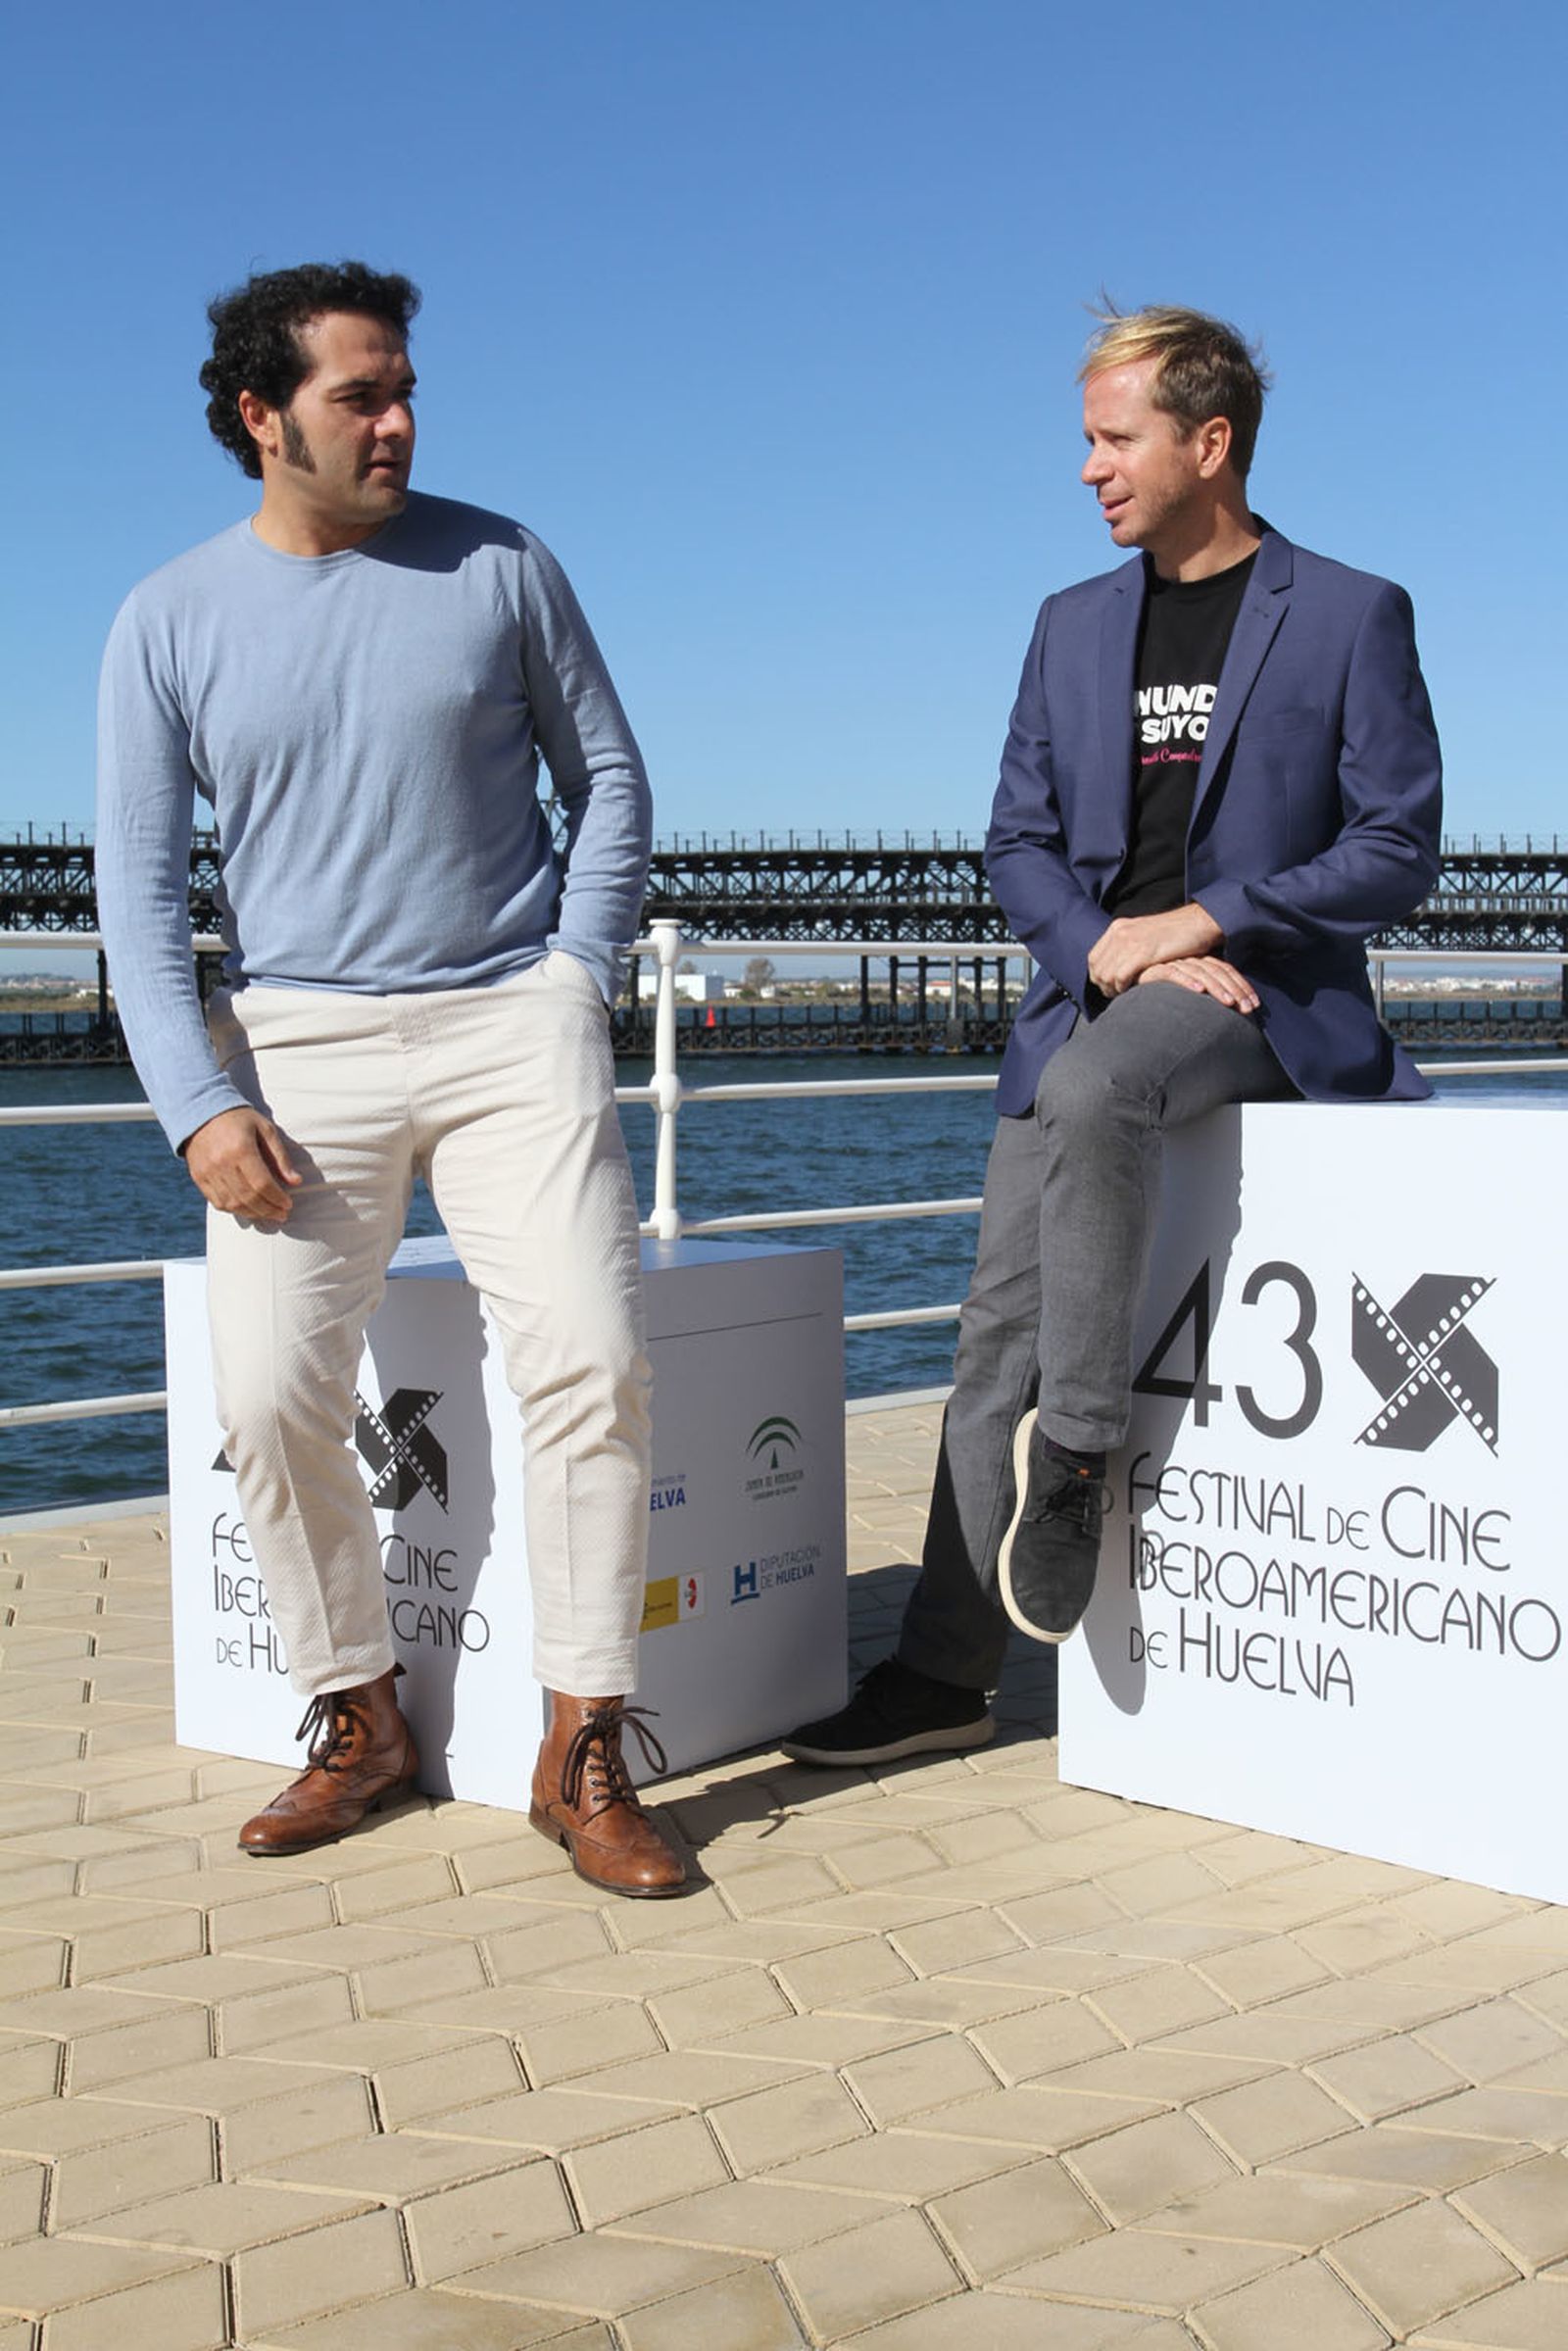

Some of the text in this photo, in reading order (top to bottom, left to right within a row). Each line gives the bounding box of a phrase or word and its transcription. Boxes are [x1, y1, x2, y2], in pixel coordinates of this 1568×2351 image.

[1131, 1258, 1323, 1440] 43
[650, 1487, 686, 1511] ELVA
[1128, 1451, 1511, 1571] FESTIVAL DE CINE
[380, 1534, 458, 1592] CINE
[1129, 1523, 1561, 1662] IBEROAMERICANO
[217, 1638, 242, 1667] DE
[1130, 1607, 1354, 1707] DE HUELVA
